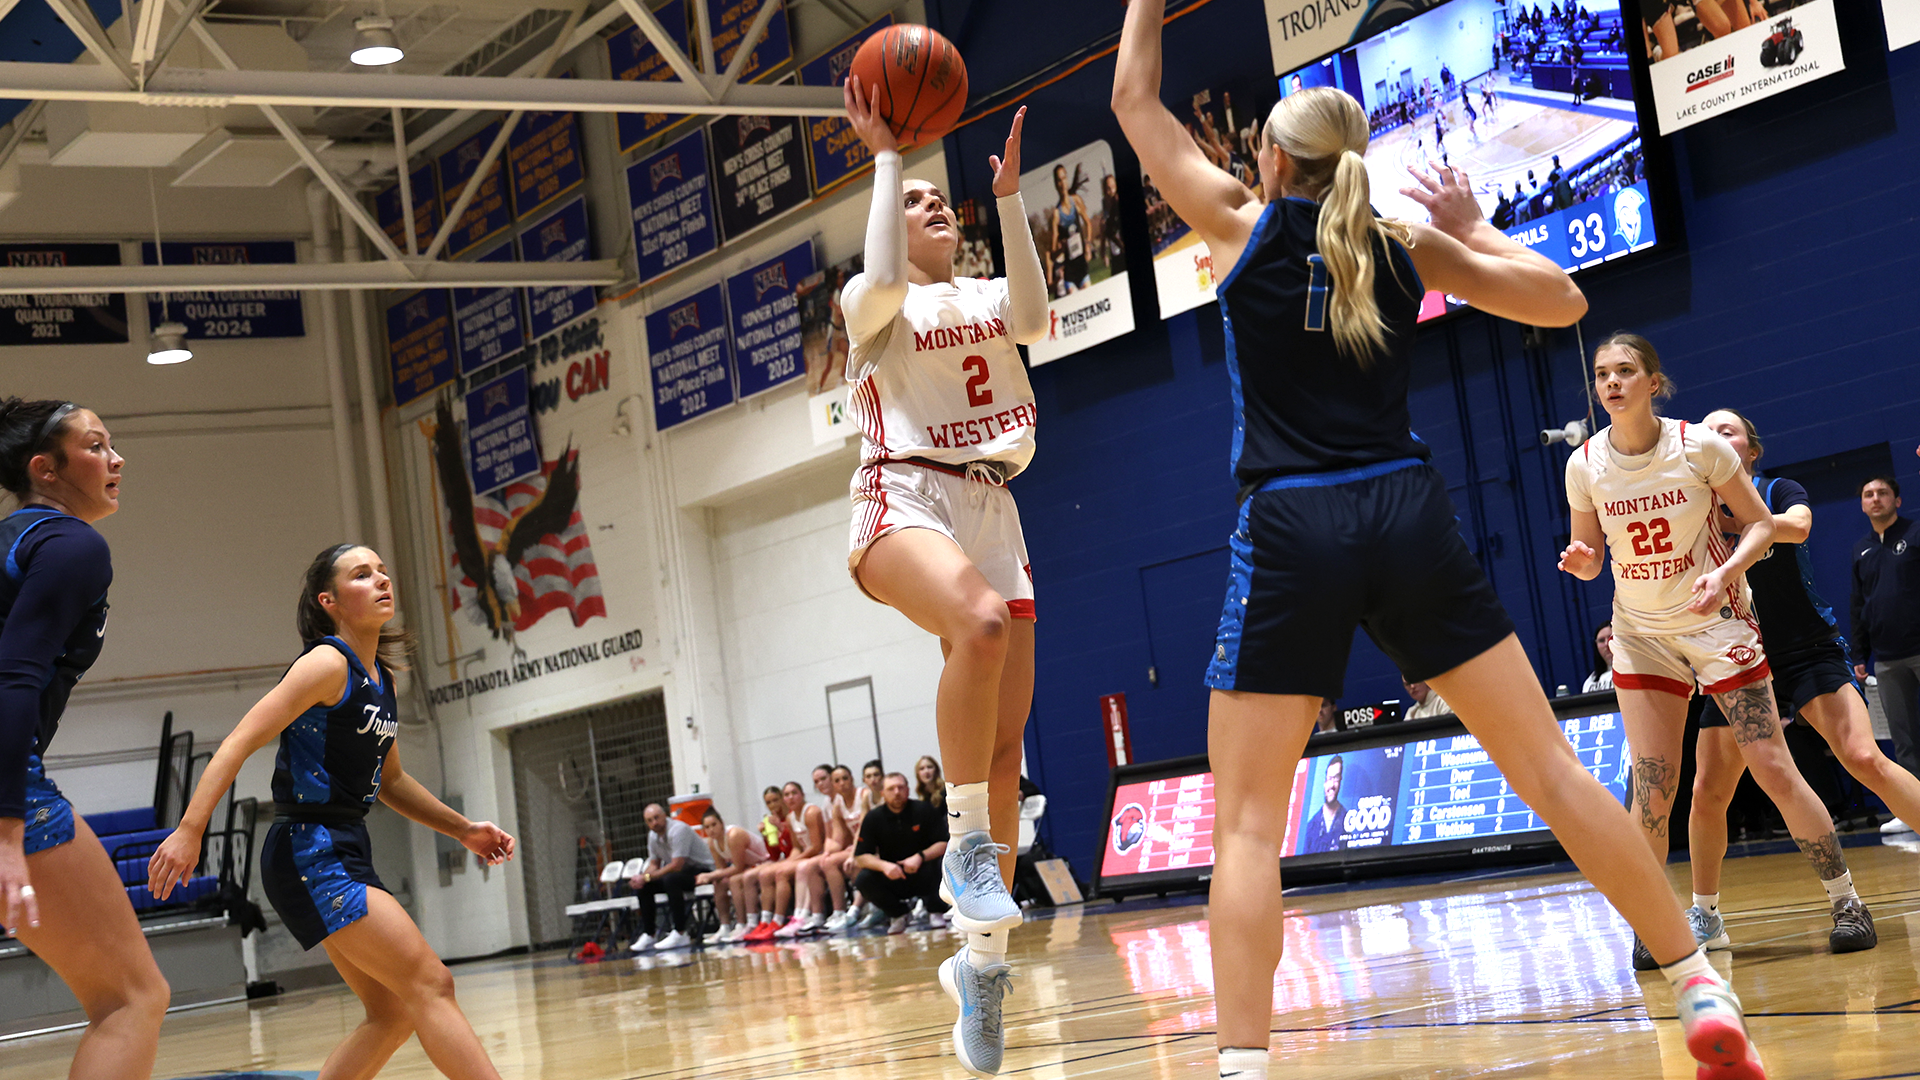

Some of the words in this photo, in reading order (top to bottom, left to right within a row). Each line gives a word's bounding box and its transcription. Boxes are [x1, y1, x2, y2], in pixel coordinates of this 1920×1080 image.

[1687, 62, 1721, 84] CASE
[1676, 104, 1697, 120] LAKE
[1701, 90, 1736, 110] COUNTY
[1741, 60, 1820, 96] INTERNATIONAL
[743, 140, 763, 165] CROSS
[763, 124, 793, 154] COUNTRY
[735, 159, 767, 188] NATIONAL
[766, 148, 784, 170] MEET
[748, 175, 769, 200] PLACE
[769, 164, 791, 189] FINISH
[652, 188, 674, 211] CROSS
[675, 172, 706, 200] COUNTRY
[640, 205, 678, 239] NATIONAL
[679, 193, 702, 218] MEET
[659, 223, 680, 248] Place
[681, 209, 706, 237] Finish
[1510, 224, 1549, 247] FOULS
[1568, 212, 1606, 258] 33
[662, 239, 688, 268] 2020
[753, 261, 788, 303] NAIA
[15, 308, 75, 325] QUALIFIER
[185, 303, 266, 320] QUALIFIER
[741, 304, 773, 328] CONNER
[1061, 297, 1112, 329] MUSTANG
[31, 324, 61, 338] 2021
[204, 320, 252, 336] 2024
[672, 339, 693, 359] CROSS
[693, 324, 725, 350] COUNTRY
[737, 324, 775, 350] NATIONAL
[774, 312, 801, 336] CHAM
[1063, 322, 1088, 338] SEEDS
[657, 355, 696, 385] NATIONAL
[696, 344, 720, 368] MEET
[751, 342, 780, 366] DISCUS
[767, 354, 795, 381] 2023
[566, 350, 611, 402] CAN
[676, 374, 700, 397] Place
[699, 362, 725, 387] Finish
[962, 355, 993, 408] 2
[679, 390, 707, 416] 2022
[475, 427, 508, 454] NATIONAL
[507, 418, 526, 439] MEET
[927, 402, 1037, 448] WESTERN
[1604, 489, 1688, 516] MONTANA
[1626, 517, 1673, 556] 22
[1618, 550, 1696, 580] WESTERN
[429, 680, 465, 706] SOUTH
[467, 670, 510, 698] DAKOTA
[512, 660, 544, 684] ARMY
[544, 642, 601, 674] NATIONAL
[603, 629, 643, 658] GUARD
[1344, 707, 1374, 724] POSS
[1589, 713, 1614, 732] REB
[1415, 740, 1437, 756] PLR
[1422, 755, 1427, 770] 1
[1594, 749, 1602, 765] 0
[1414, 790, 1425, 806] 11
[1499, 779, 1507, 795] 3
[1344, 805, 1391, 833] GOOD
[1411, 807, 1424, 823] 25
[1497, 797, 1505, 813] 0
[1435, 820, 1475, 838] Watkins
[1494, 816, 1503, 832] 2
[1527, 812, 1534, 828] 1
[1471, 844, 1512, 854] DAKTRONICS
